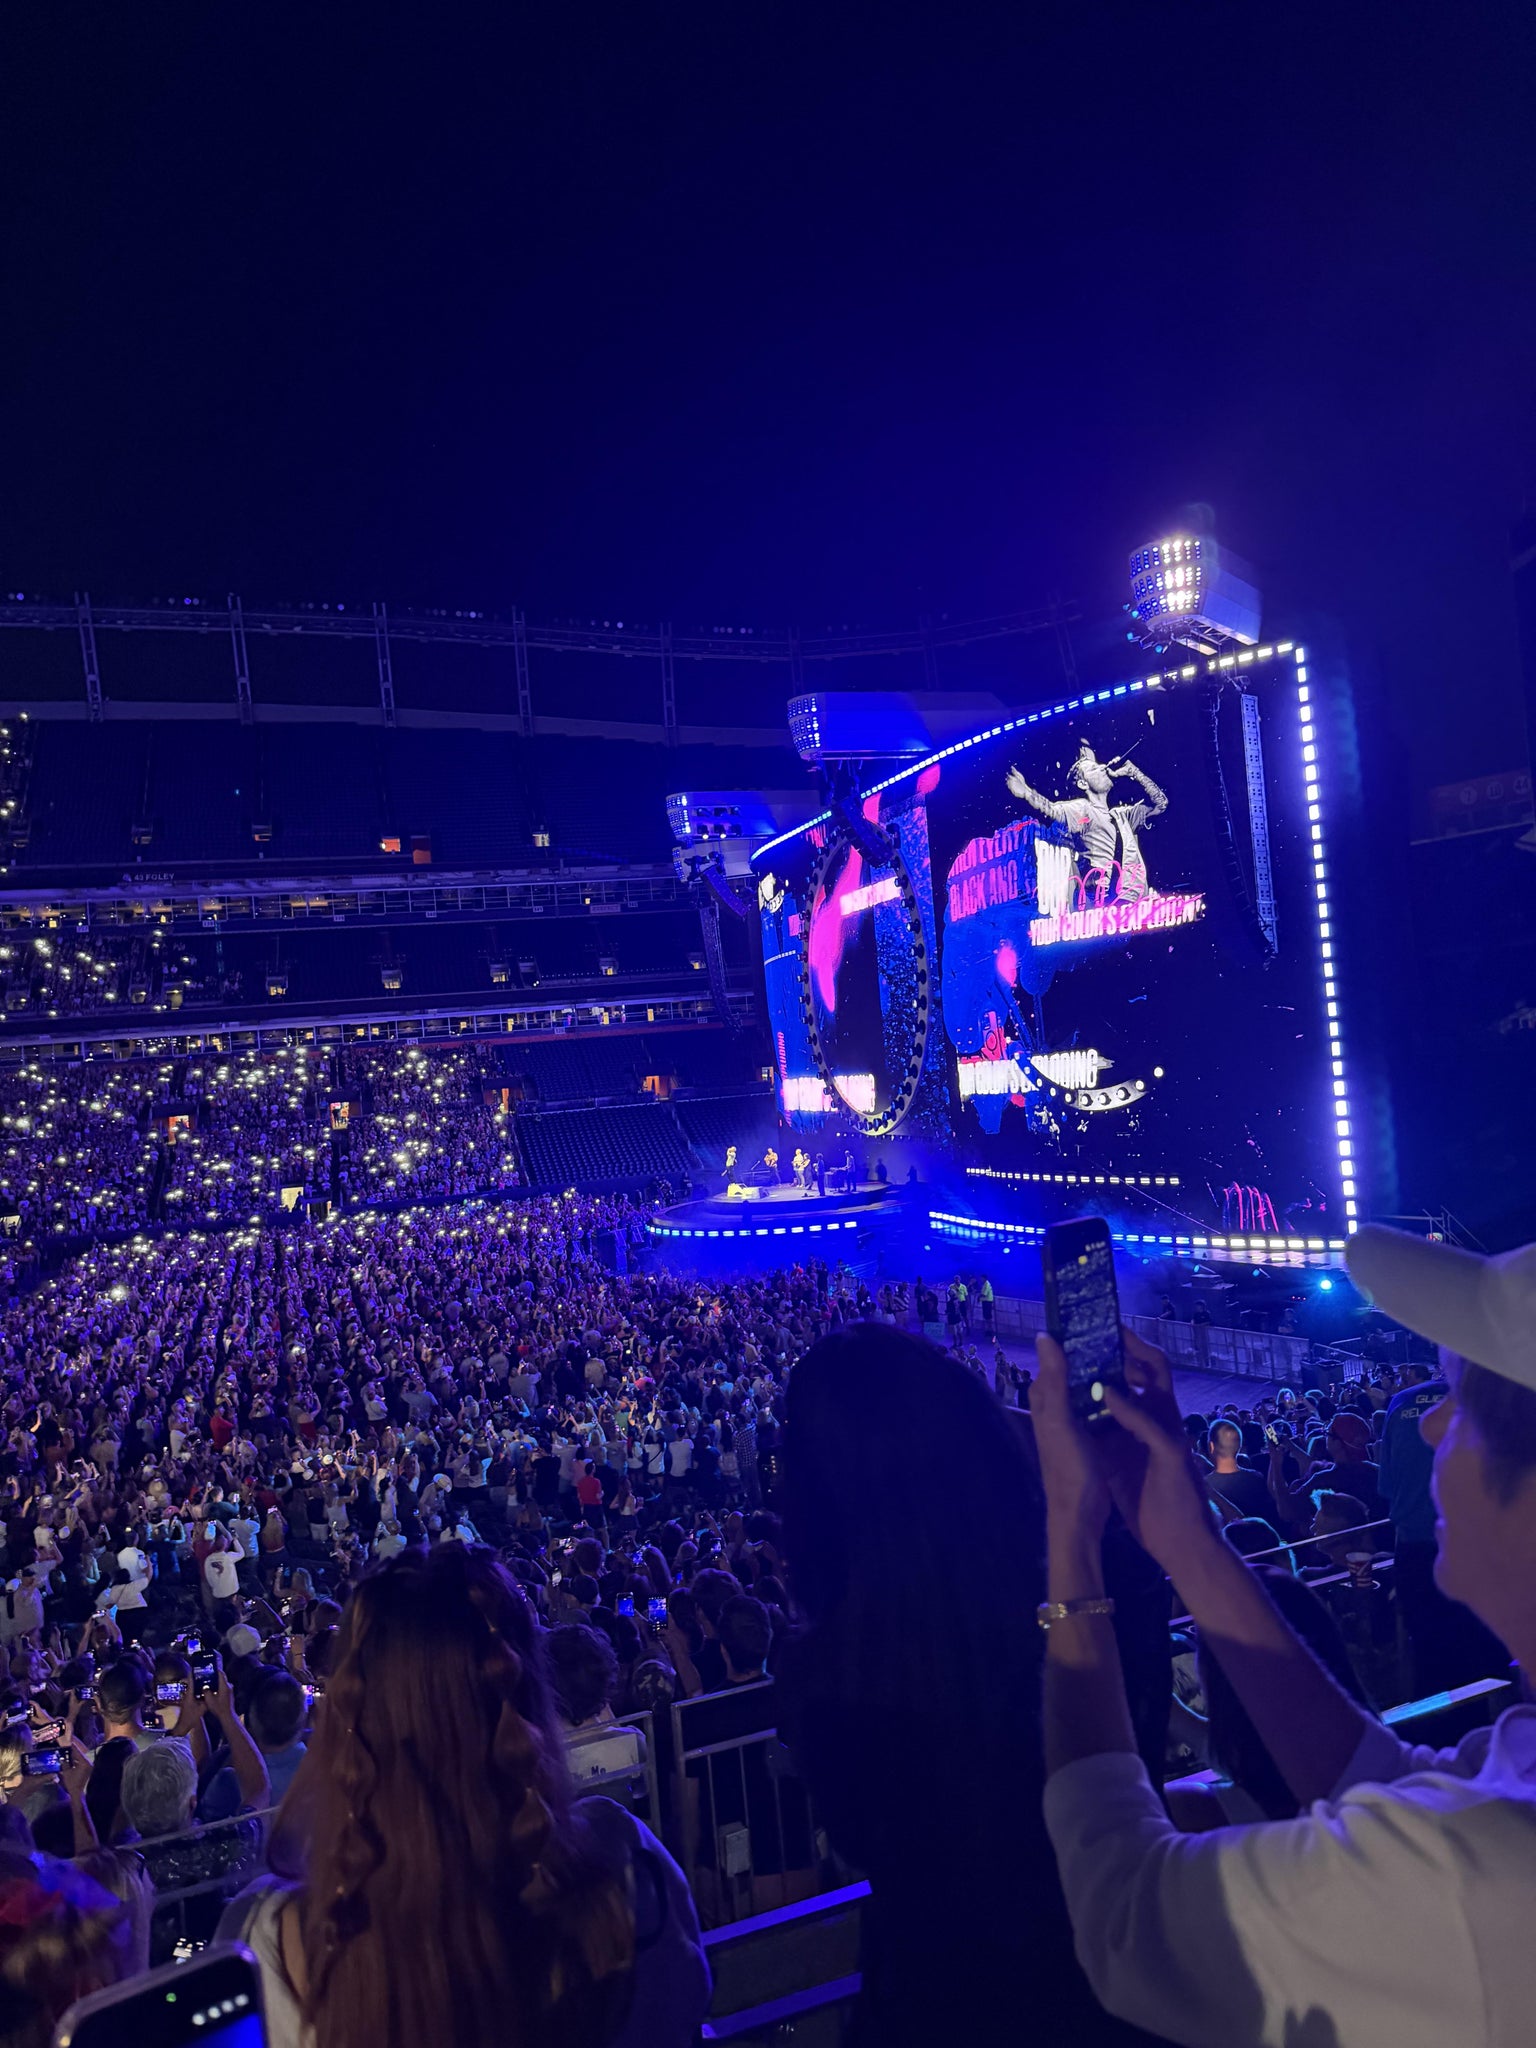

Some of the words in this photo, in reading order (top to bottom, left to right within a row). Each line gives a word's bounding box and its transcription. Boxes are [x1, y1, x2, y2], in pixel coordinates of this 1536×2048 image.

[145, 873, 175, 881] FOLEY
[949, 871, 987, 922] BLACK
[989, 859, 1018, 906] AND
